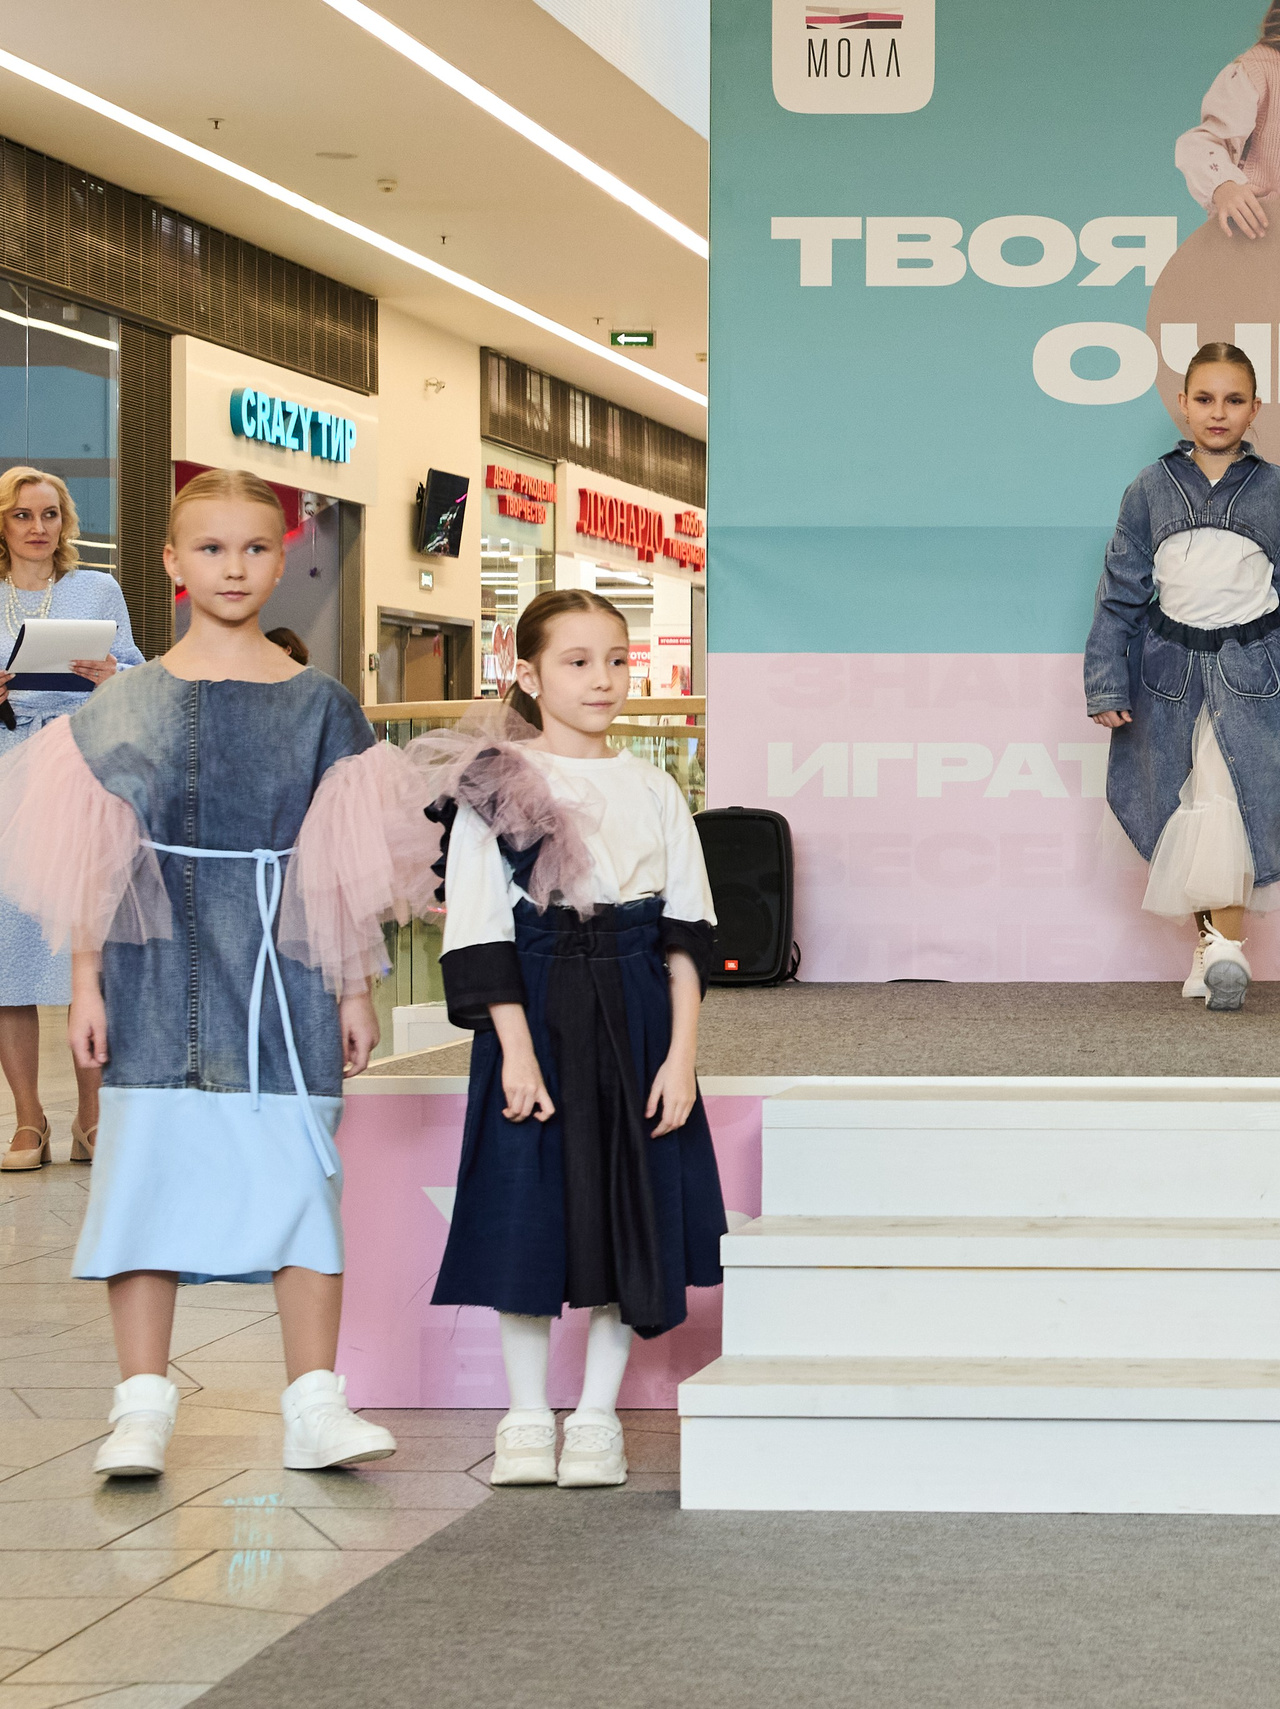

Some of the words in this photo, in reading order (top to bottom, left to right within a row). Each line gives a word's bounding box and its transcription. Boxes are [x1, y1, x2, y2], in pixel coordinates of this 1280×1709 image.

[771, 214, 1177, 288] ТВОЯ
[240, 387, 313, 453] CRAZY
[317, 410, 357, 464] ТИР
[492, 464, 516, 490] ДЕКОР
[504, 494, 546, 525] ТВОРЧЕСТВО
[579, 488, 665, 563] ЛЕОНАРДО
